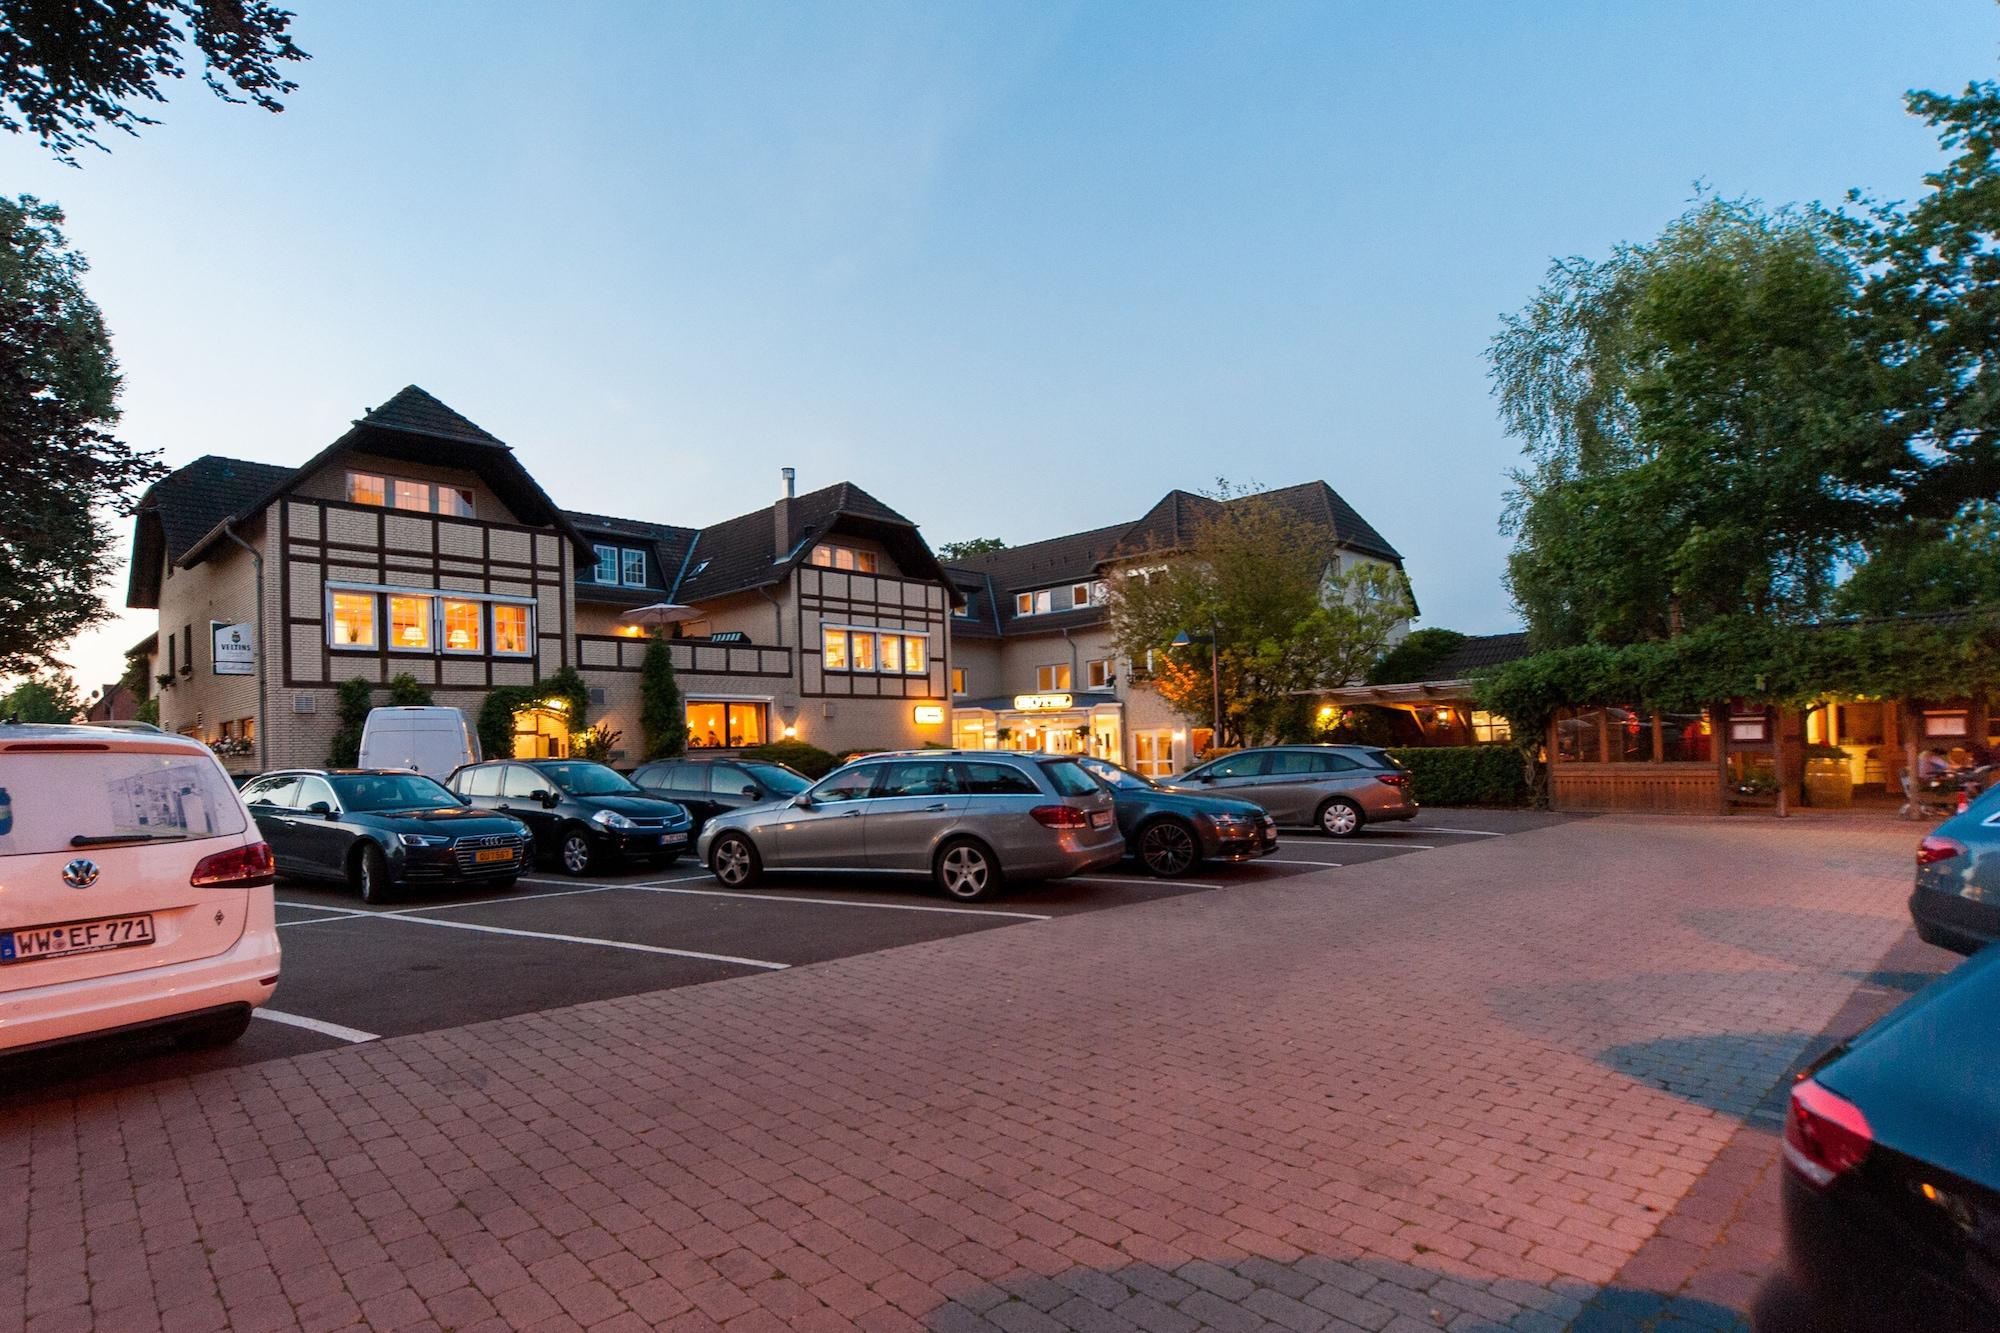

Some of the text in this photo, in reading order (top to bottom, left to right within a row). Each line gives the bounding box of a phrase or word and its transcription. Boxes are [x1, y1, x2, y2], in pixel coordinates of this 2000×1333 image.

[17, 932, 49, 954] WW
[69, 925, 100, 947] EF
[106, 919, 149, 942] 771
